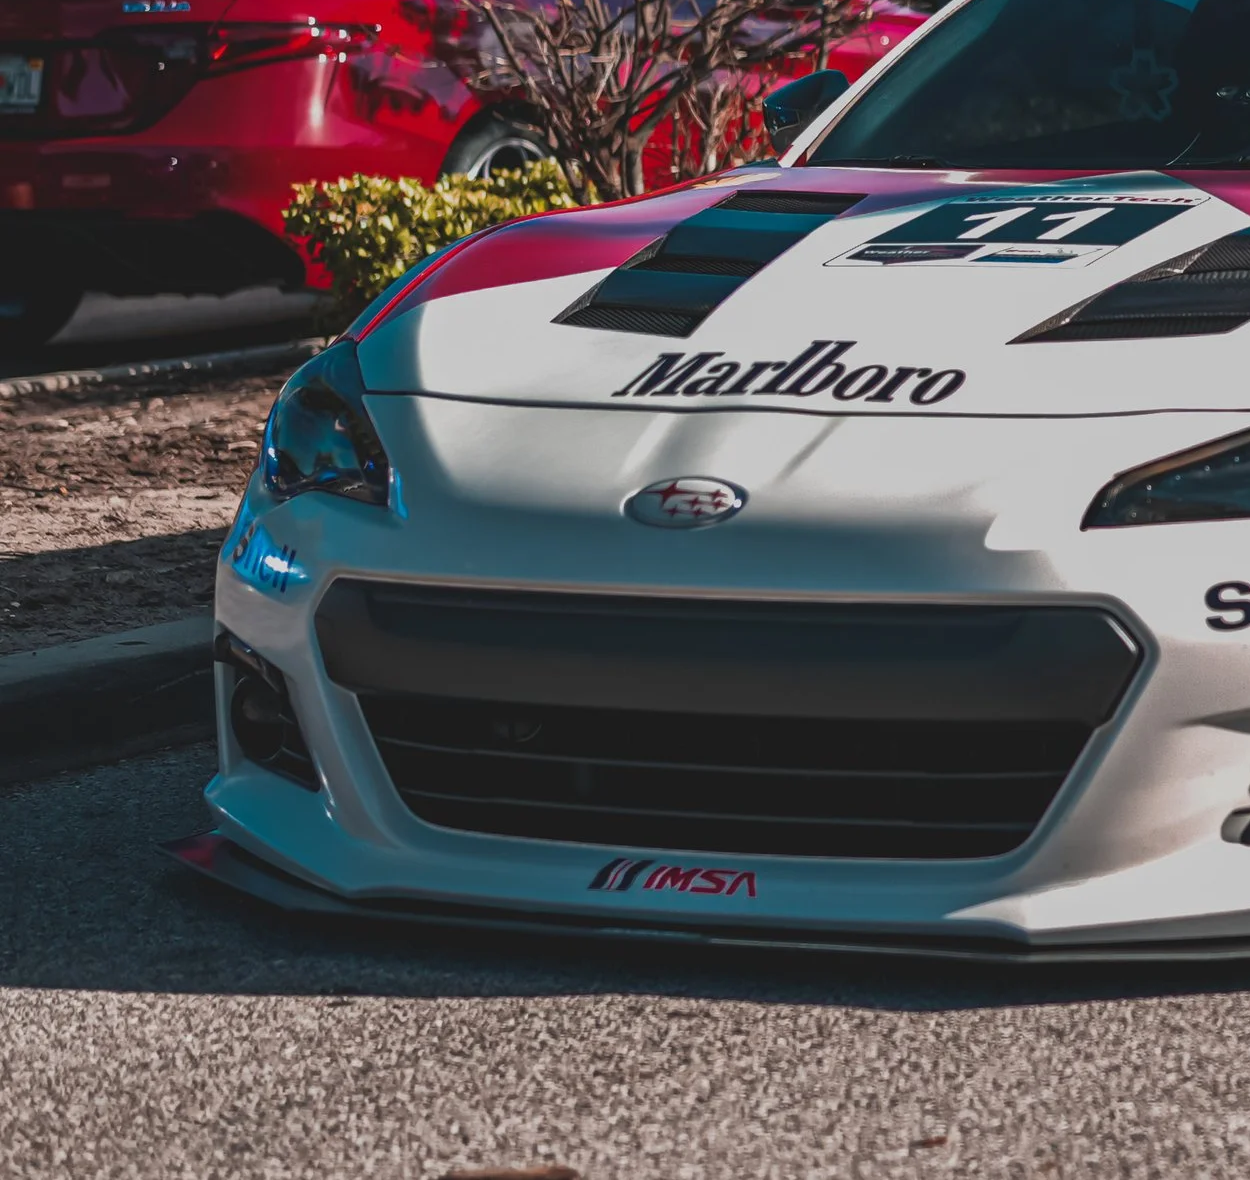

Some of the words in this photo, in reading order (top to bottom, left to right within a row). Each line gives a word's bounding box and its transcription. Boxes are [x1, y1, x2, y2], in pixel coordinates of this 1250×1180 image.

[966, 195, 1196, 204] WeatherTech
[957, 207, 1115, 240] 11
[611, 339, 967, 405] Marlboro
[642, 865, 757, 898] IMSA
